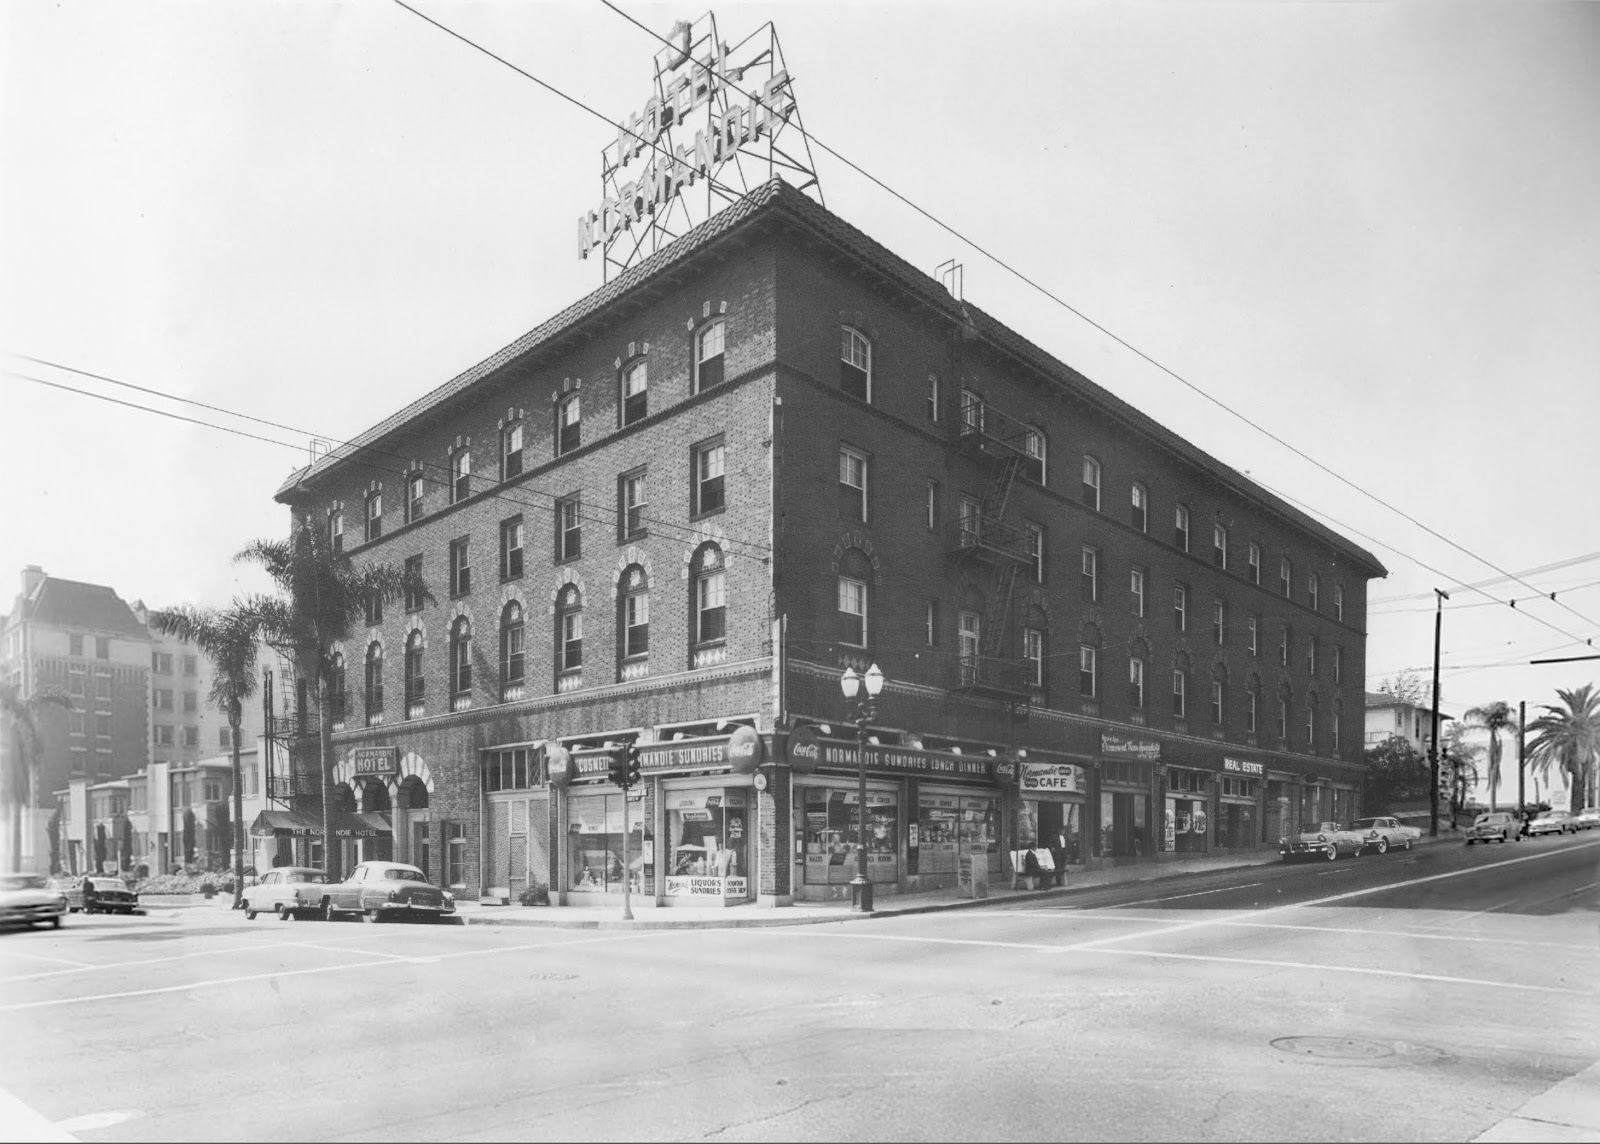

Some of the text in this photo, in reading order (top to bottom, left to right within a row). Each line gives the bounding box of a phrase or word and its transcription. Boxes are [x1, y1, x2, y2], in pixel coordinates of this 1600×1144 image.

[617, 40, 743, 168] HOTEL
[578, 68, 791, 260] NORMANDIE
[679, 745, 723, 765] SUNDRIES
[826, 747, 985, 774] NORMADIE SUNDRIES LUNCH DINNER
[357, 758, 391, 772] HOTEL
[1225, 758, 1263, 774] REAL ESTATE
[1040, 777, 1067, 787] CAFE
[292, 828, 378, 837] THE NORNDIE HOTEL
[691, 879, 722, 887] LIQUORS
[690, 887, 722, 895] SUNDRIES
